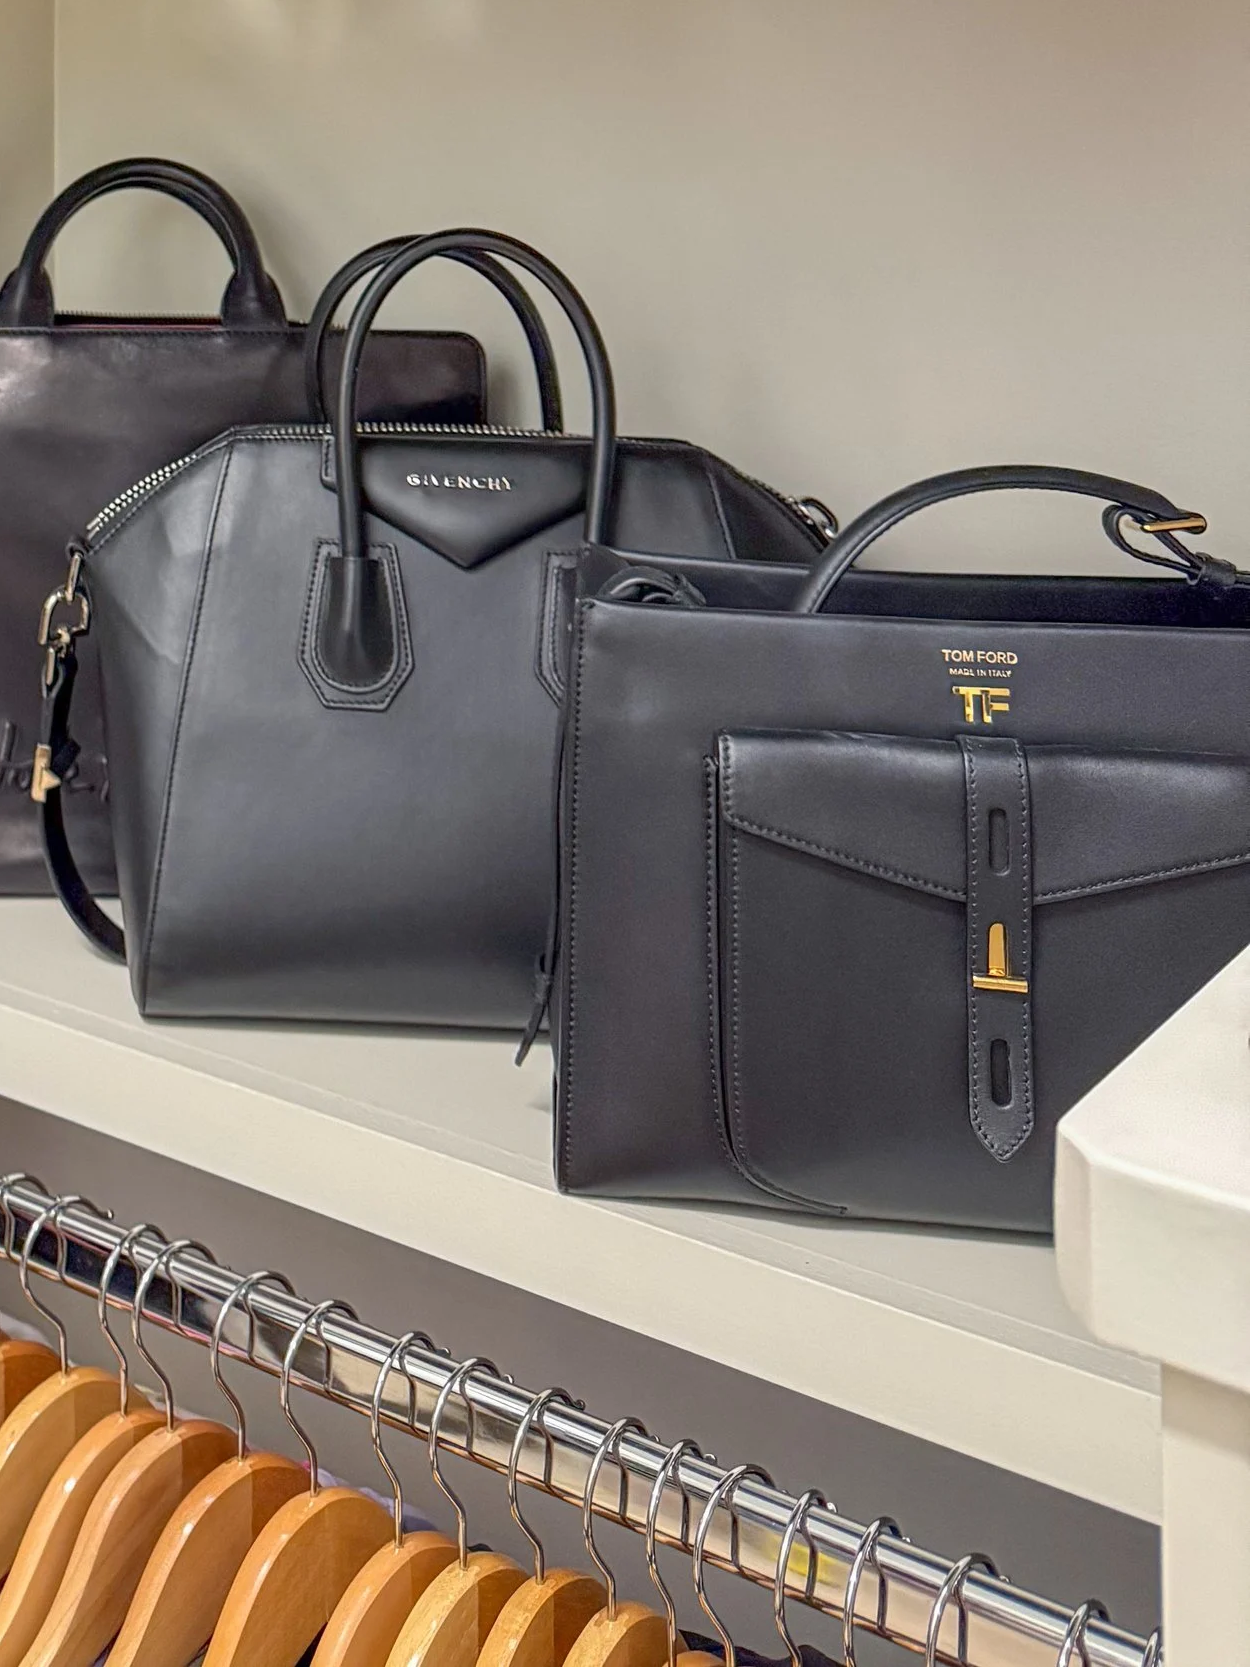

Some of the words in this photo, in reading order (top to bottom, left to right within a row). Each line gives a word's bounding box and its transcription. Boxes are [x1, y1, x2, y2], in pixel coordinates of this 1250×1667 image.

[406, 473, 511, 491] GIVENCHY
[941, 649, 975, 663] TOM
[977, 650, 1019, 665] FORD
[976, 669, 987, 677] IN
[988, 669, 1012, 678] ITALY
[952, 685, 1011, 724] TF
